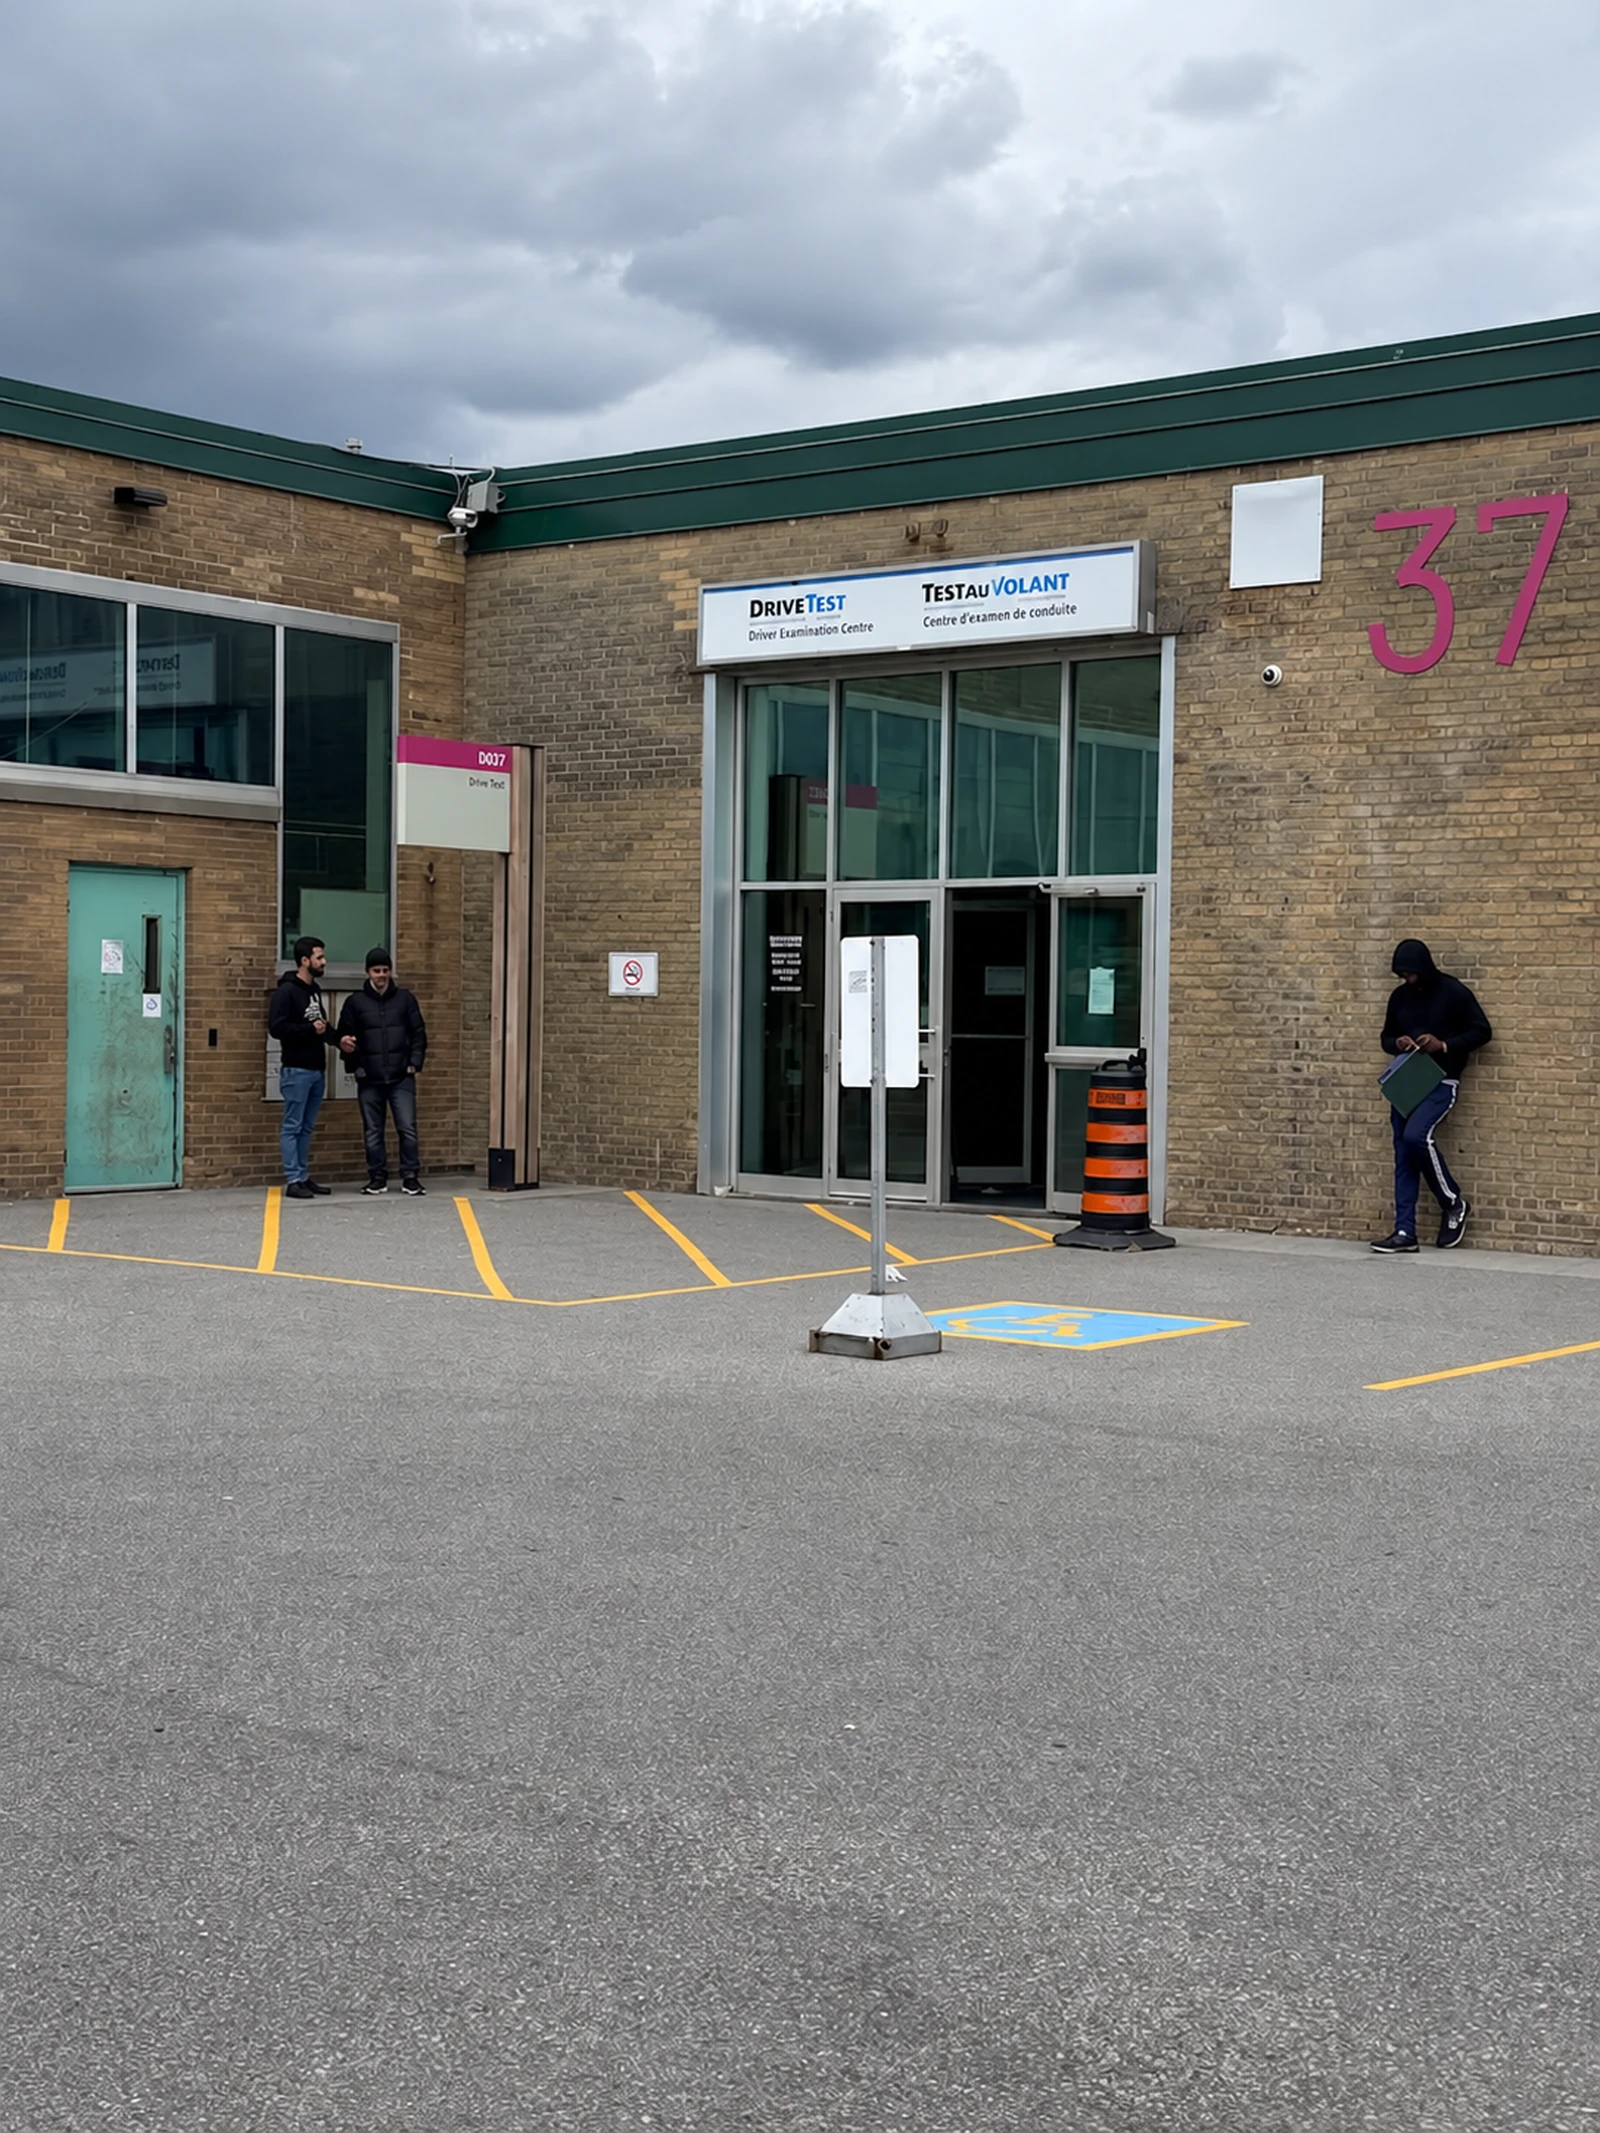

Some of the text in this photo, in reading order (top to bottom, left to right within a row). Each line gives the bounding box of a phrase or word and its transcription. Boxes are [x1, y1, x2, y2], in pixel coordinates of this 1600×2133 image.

[1368, 492, 1569, 674] 37
[923, 602, 1078, 628] Centre d'examen de conduite
[748, 621, 875, 641] Driver Examination Centre
[478, 751, 507, 767] D037
[468, 776, 489, 788] Drive
